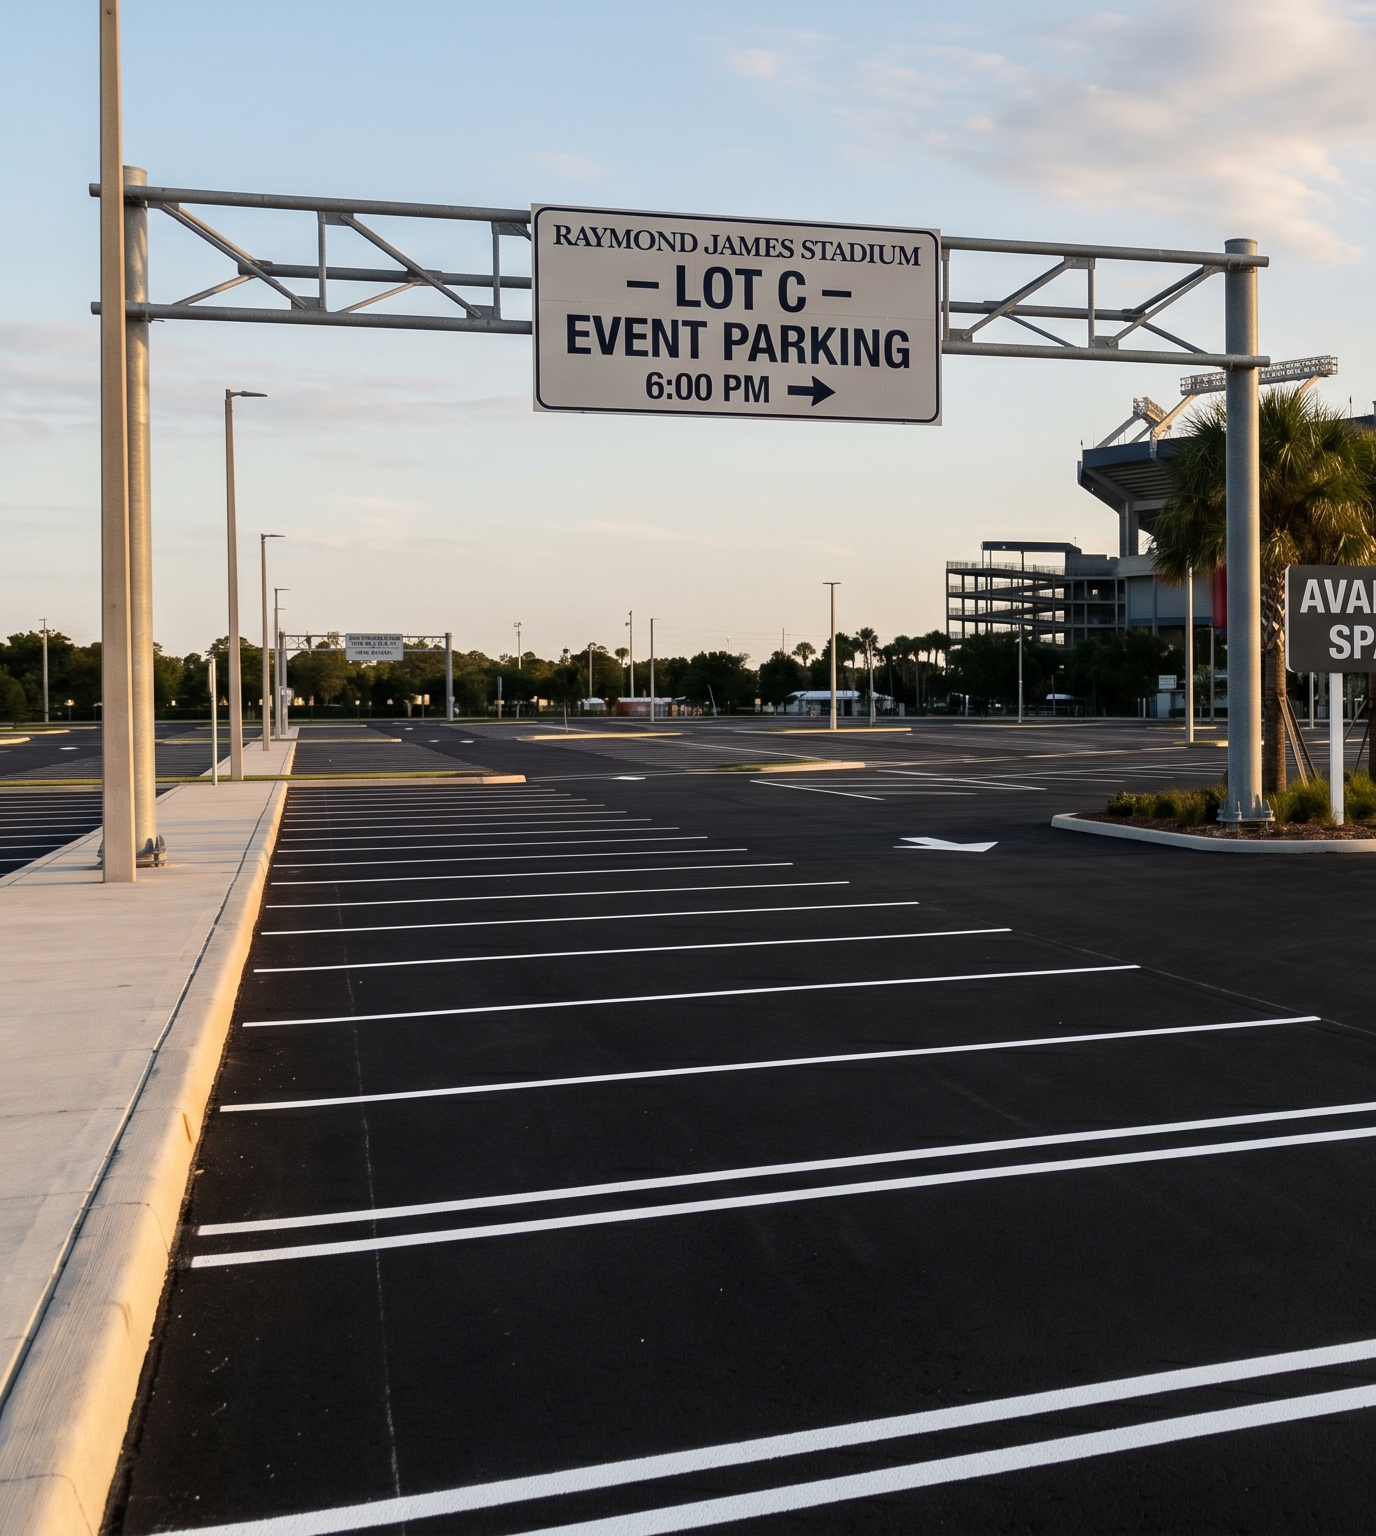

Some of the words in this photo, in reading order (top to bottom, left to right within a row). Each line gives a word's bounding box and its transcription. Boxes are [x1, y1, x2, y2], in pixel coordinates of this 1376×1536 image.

[553, 224, 698, 254] RAYMOND
[704, 233, 795, 260] JAMES
[801, 239, 921, 267] STADIUM
[676, 264, 762, 311] LOT
[778, 269, 807, 313] C
[566, 313, 708, 360] EVENT
[723, 321, 911, 369] PARKING
[645, 371, 713, 401] 6:00
[723, 374, 770, 404] PM
